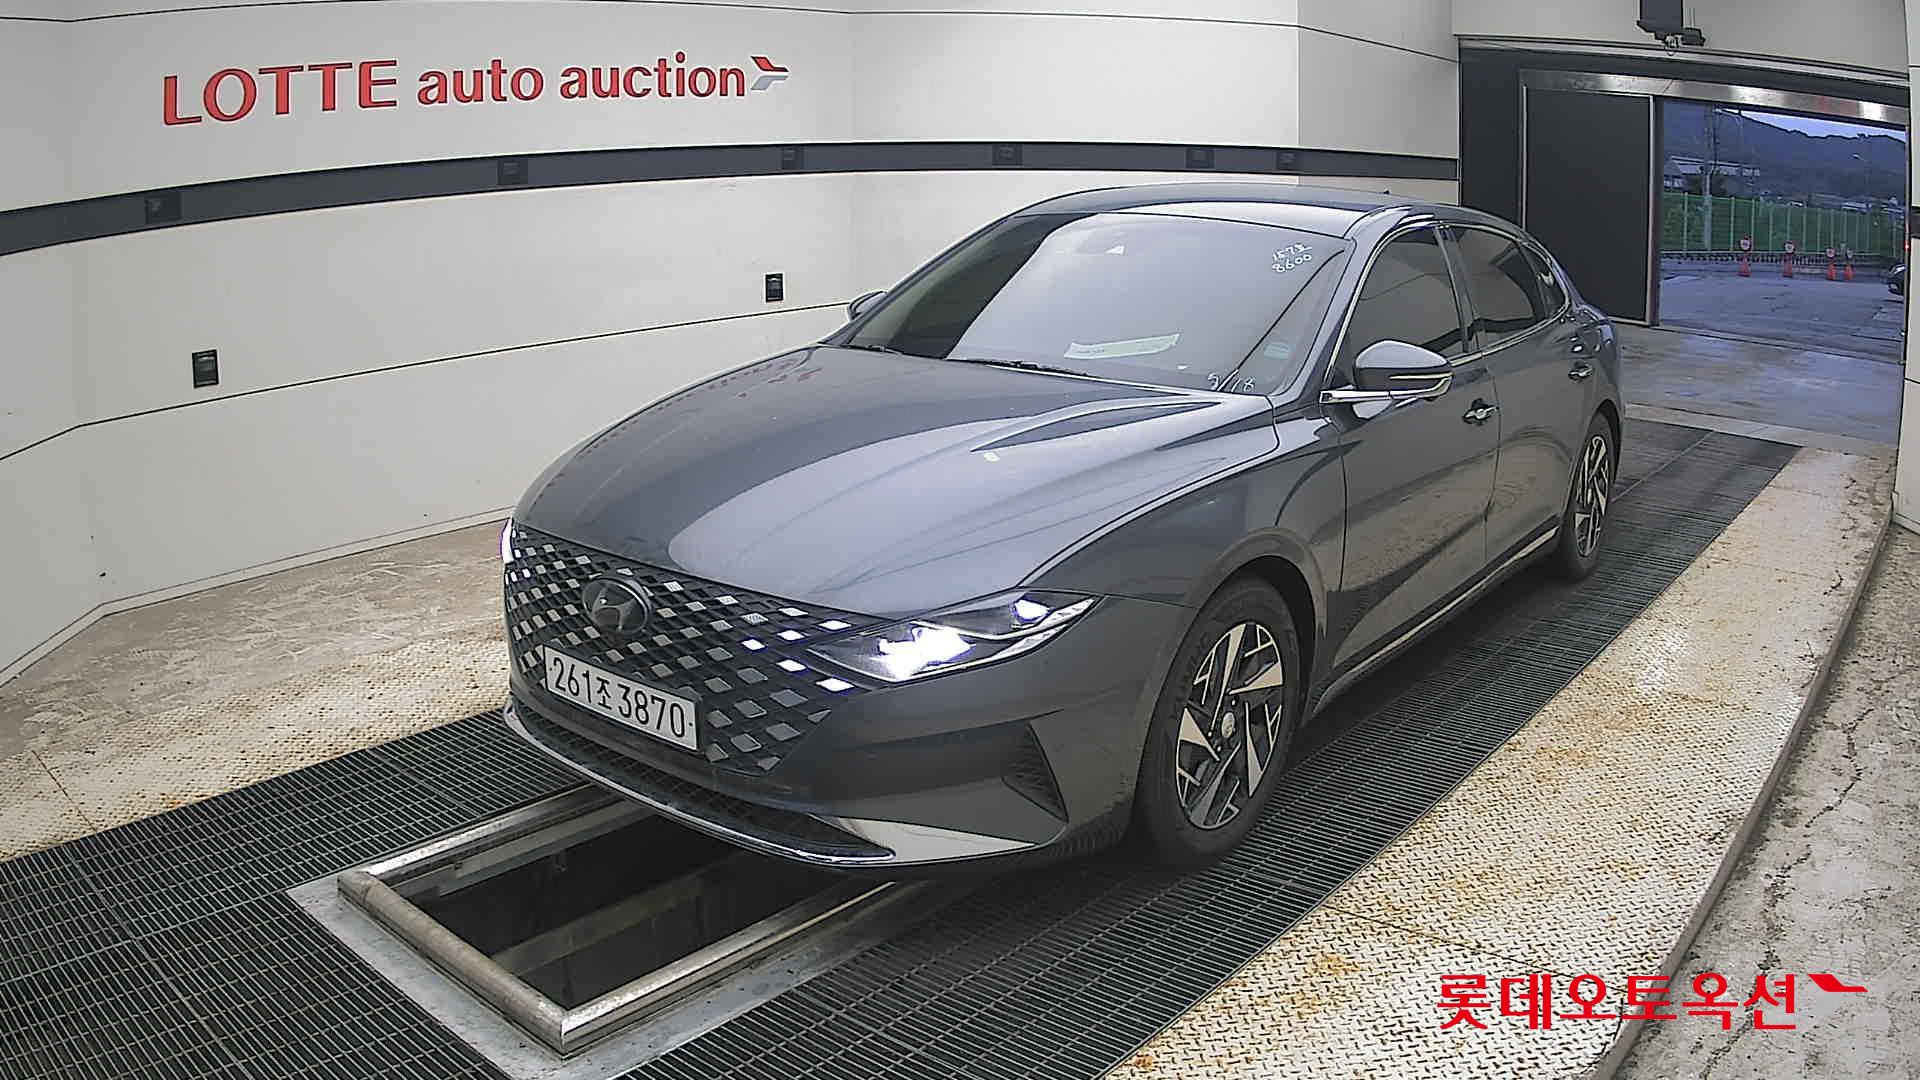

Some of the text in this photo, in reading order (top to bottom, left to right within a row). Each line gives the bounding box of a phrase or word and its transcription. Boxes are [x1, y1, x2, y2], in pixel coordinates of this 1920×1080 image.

[163, 53, 746, 125] LOTTE auto auction
[553, 656, 686, 738] 261조3870
